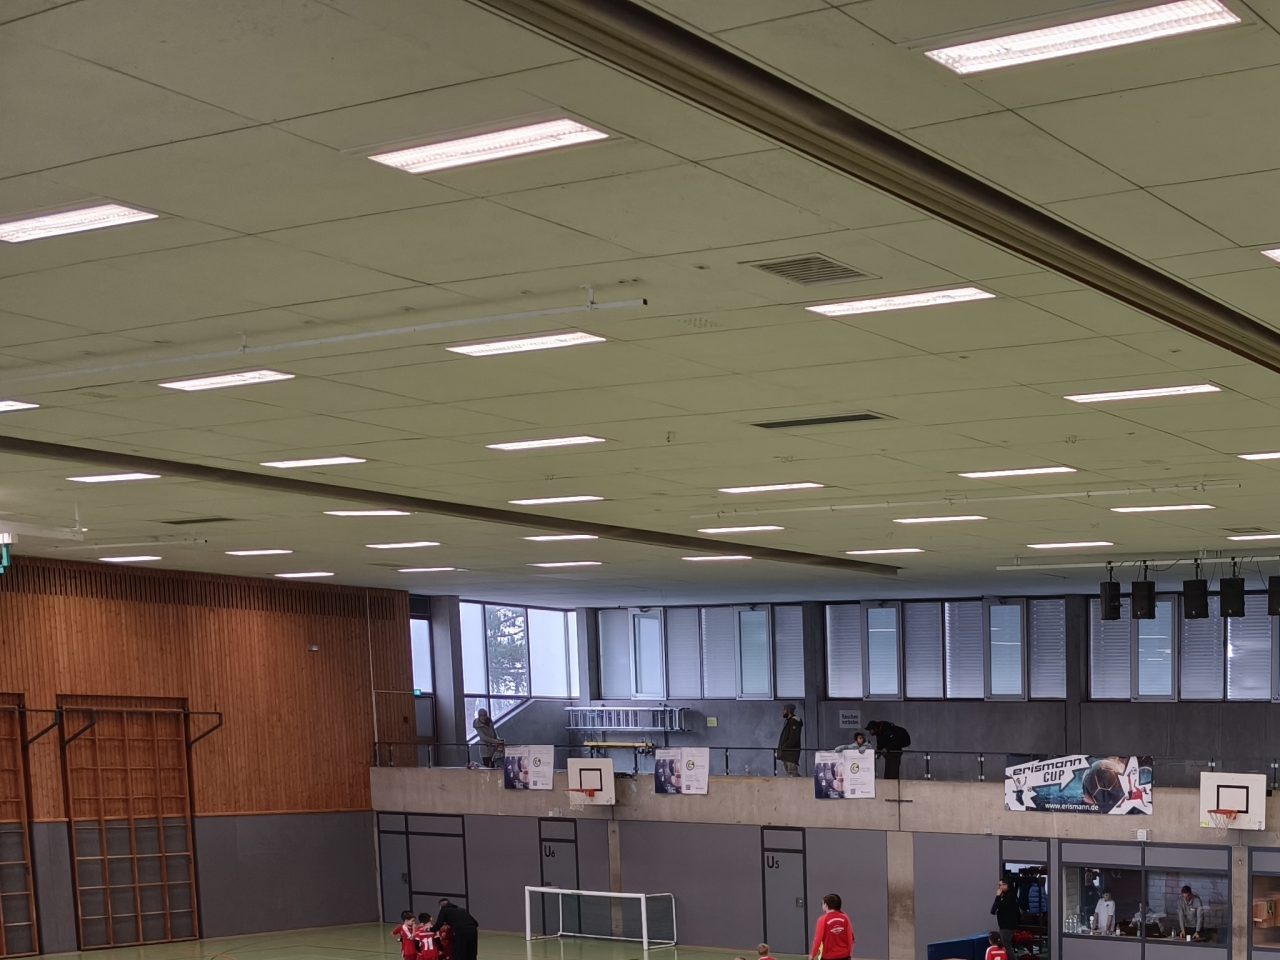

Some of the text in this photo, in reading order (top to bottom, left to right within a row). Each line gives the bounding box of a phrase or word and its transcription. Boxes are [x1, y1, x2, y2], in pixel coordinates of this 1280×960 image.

[1012, 758, 1082, 776] erismann
[1043, 769, 1065, 783] CUP
[1045, 802, 1099, 811] www.erismann.de
[766, 855, 780, 869] U5
[422, 937, 434, 951] 11
